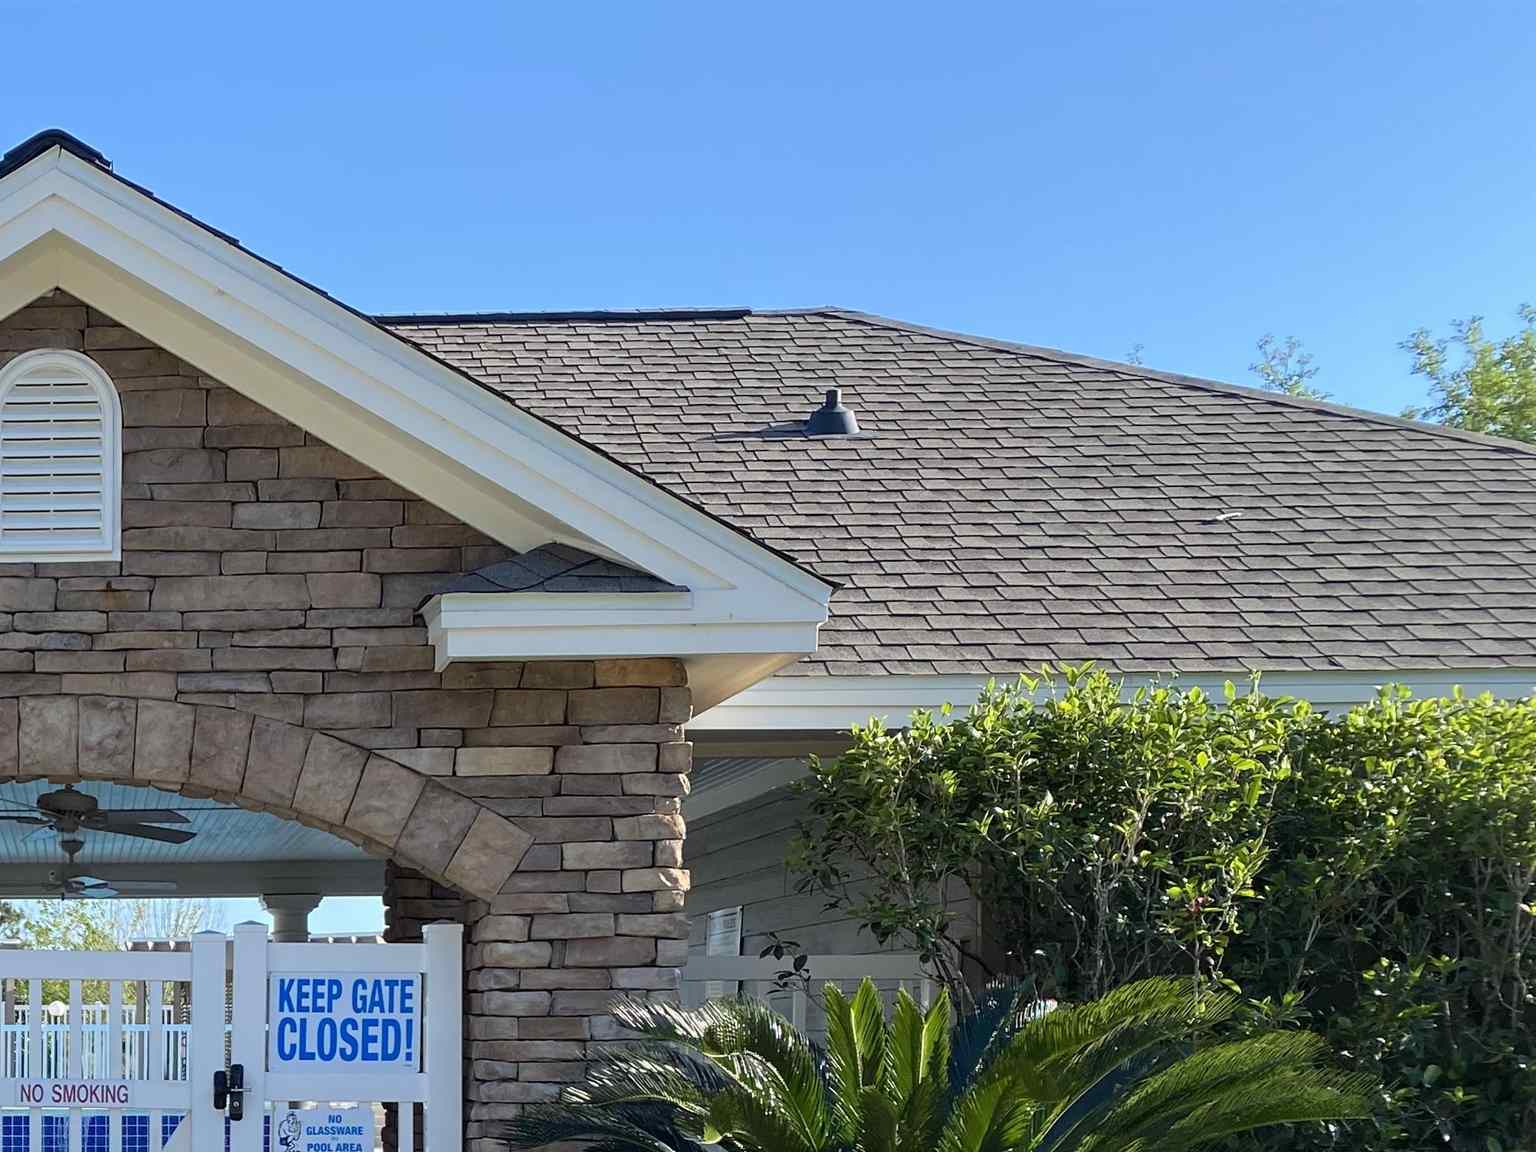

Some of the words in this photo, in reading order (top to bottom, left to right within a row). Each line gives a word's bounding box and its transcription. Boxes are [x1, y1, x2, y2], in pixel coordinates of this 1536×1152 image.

[278, 978, 343, 1013] KEEP
[352, 979, 414, 1014] GATE
[277, 1017, 414, 1062] CLOSED!
[20, 1084, 44, 1103] NO
[52, 1084, 129, 1103] SMOKING
[328, 1114, 342, 1124] NO
[306, 1126, 364, 1136] GLASSWARE
[307, 1143, 333, 1152] POOL
[336, 1143, 363, 1152] AREA
